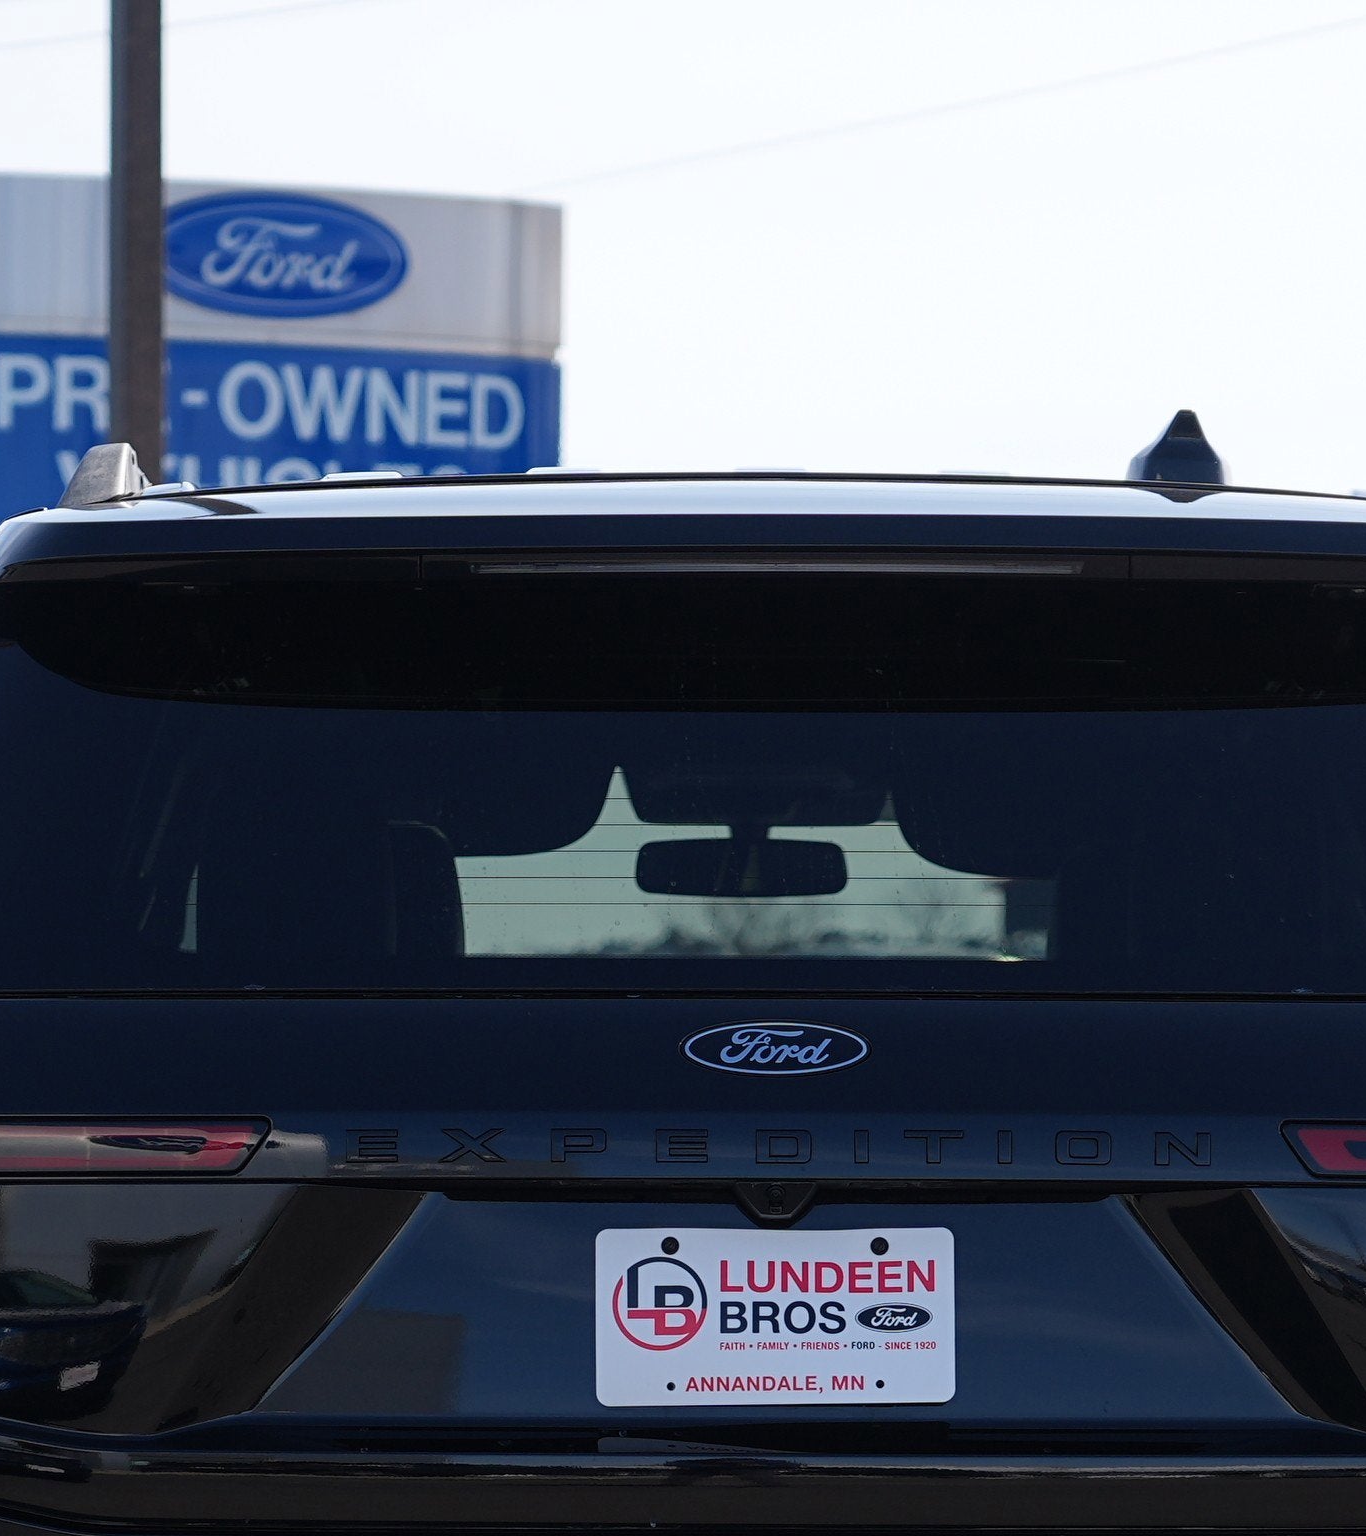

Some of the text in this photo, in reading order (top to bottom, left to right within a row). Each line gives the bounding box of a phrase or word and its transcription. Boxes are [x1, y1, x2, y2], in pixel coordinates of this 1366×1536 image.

[200, 216, 360, 292] Ford
[719, 1028, 833, 1065] Ford
[344, 1127, 1213, 1167] EXPEDITION
[719, 1259, 936, 1294] LUNDEEN
[719, 1300, 847, 1335] BROS
[870, 1306, 919, 1327] Ford
[719, 1341, 937, 1351] FAITH FAMILY FRIENDS FORD SINCE 1920
[684, 1375, 865, 1394] ANNANDALE, MN
